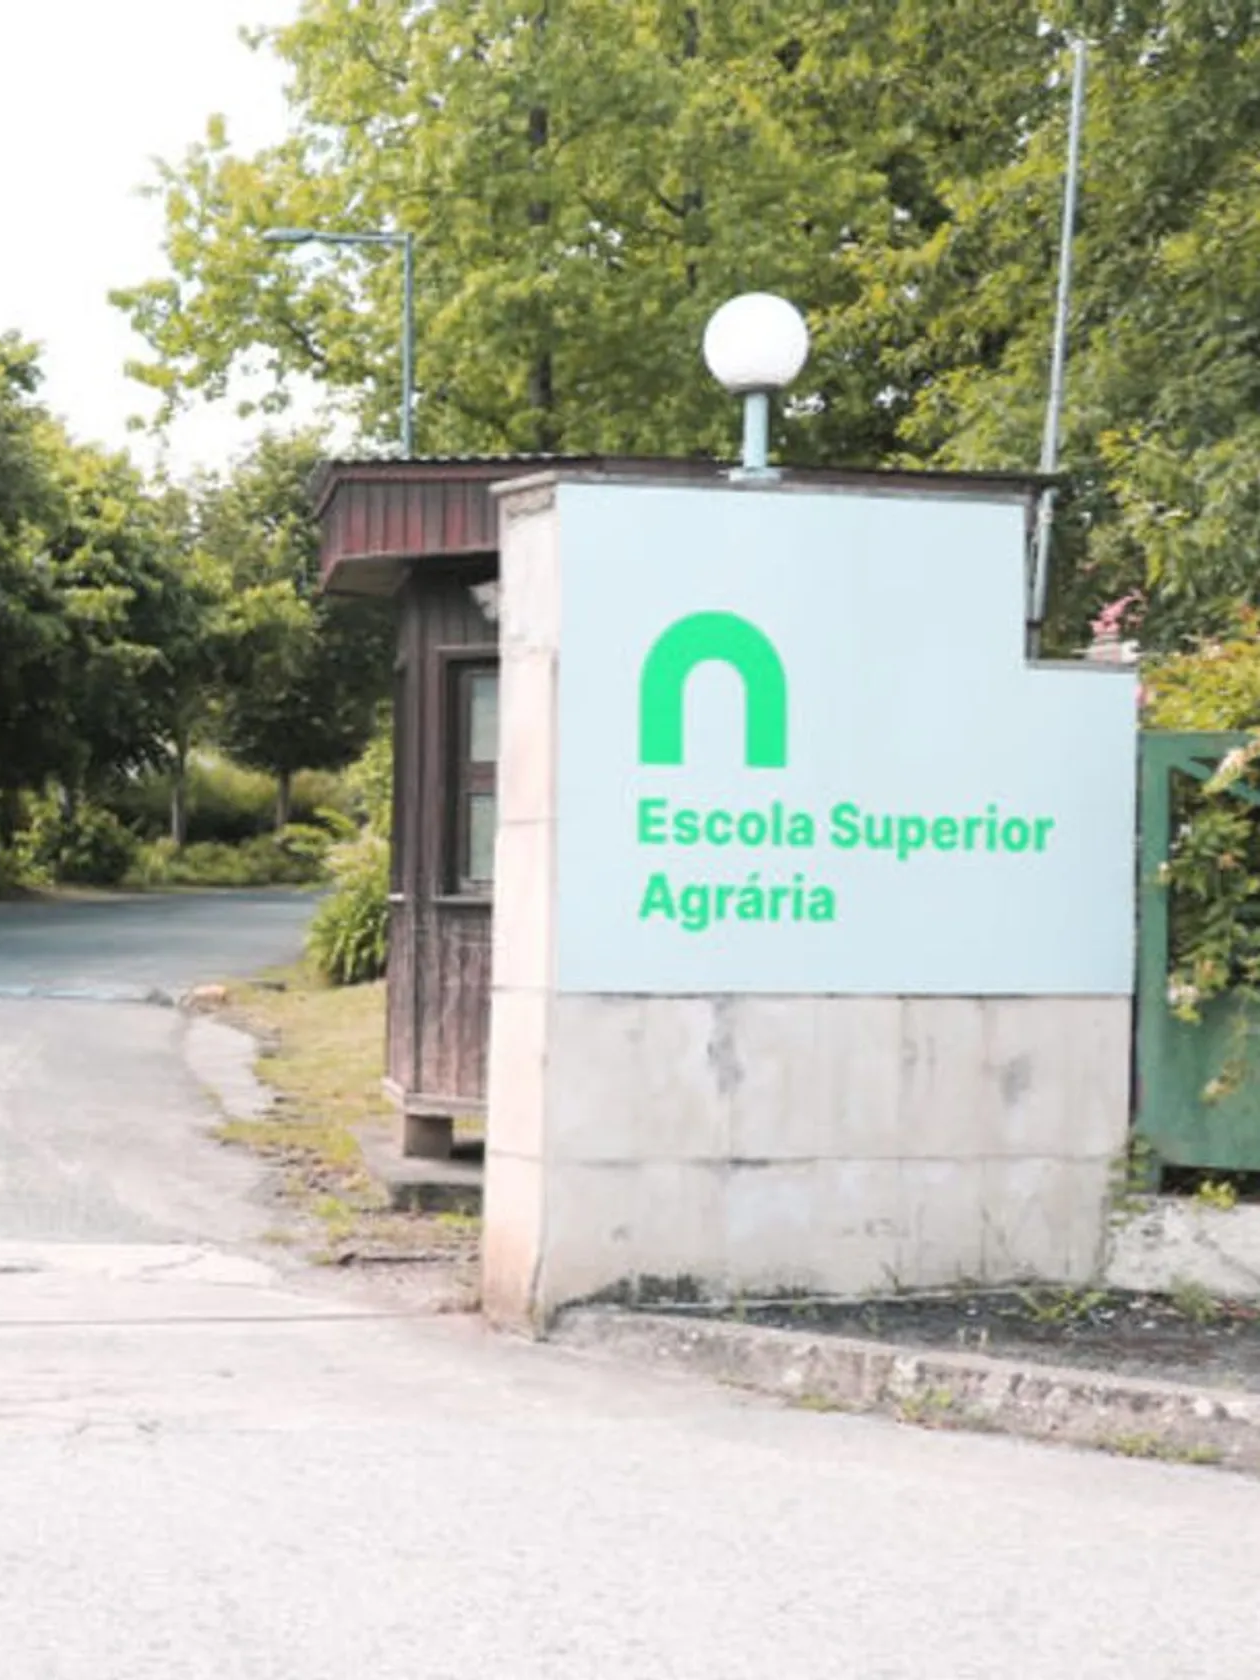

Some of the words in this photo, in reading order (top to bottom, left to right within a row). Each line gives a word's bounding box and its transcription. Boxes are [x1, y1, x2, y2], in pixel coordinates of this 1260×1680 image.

[636, 798, 815, 849] Escola
[829, 801, 1056, 862] Superior
[638, 871, 836, 933] Agrária
